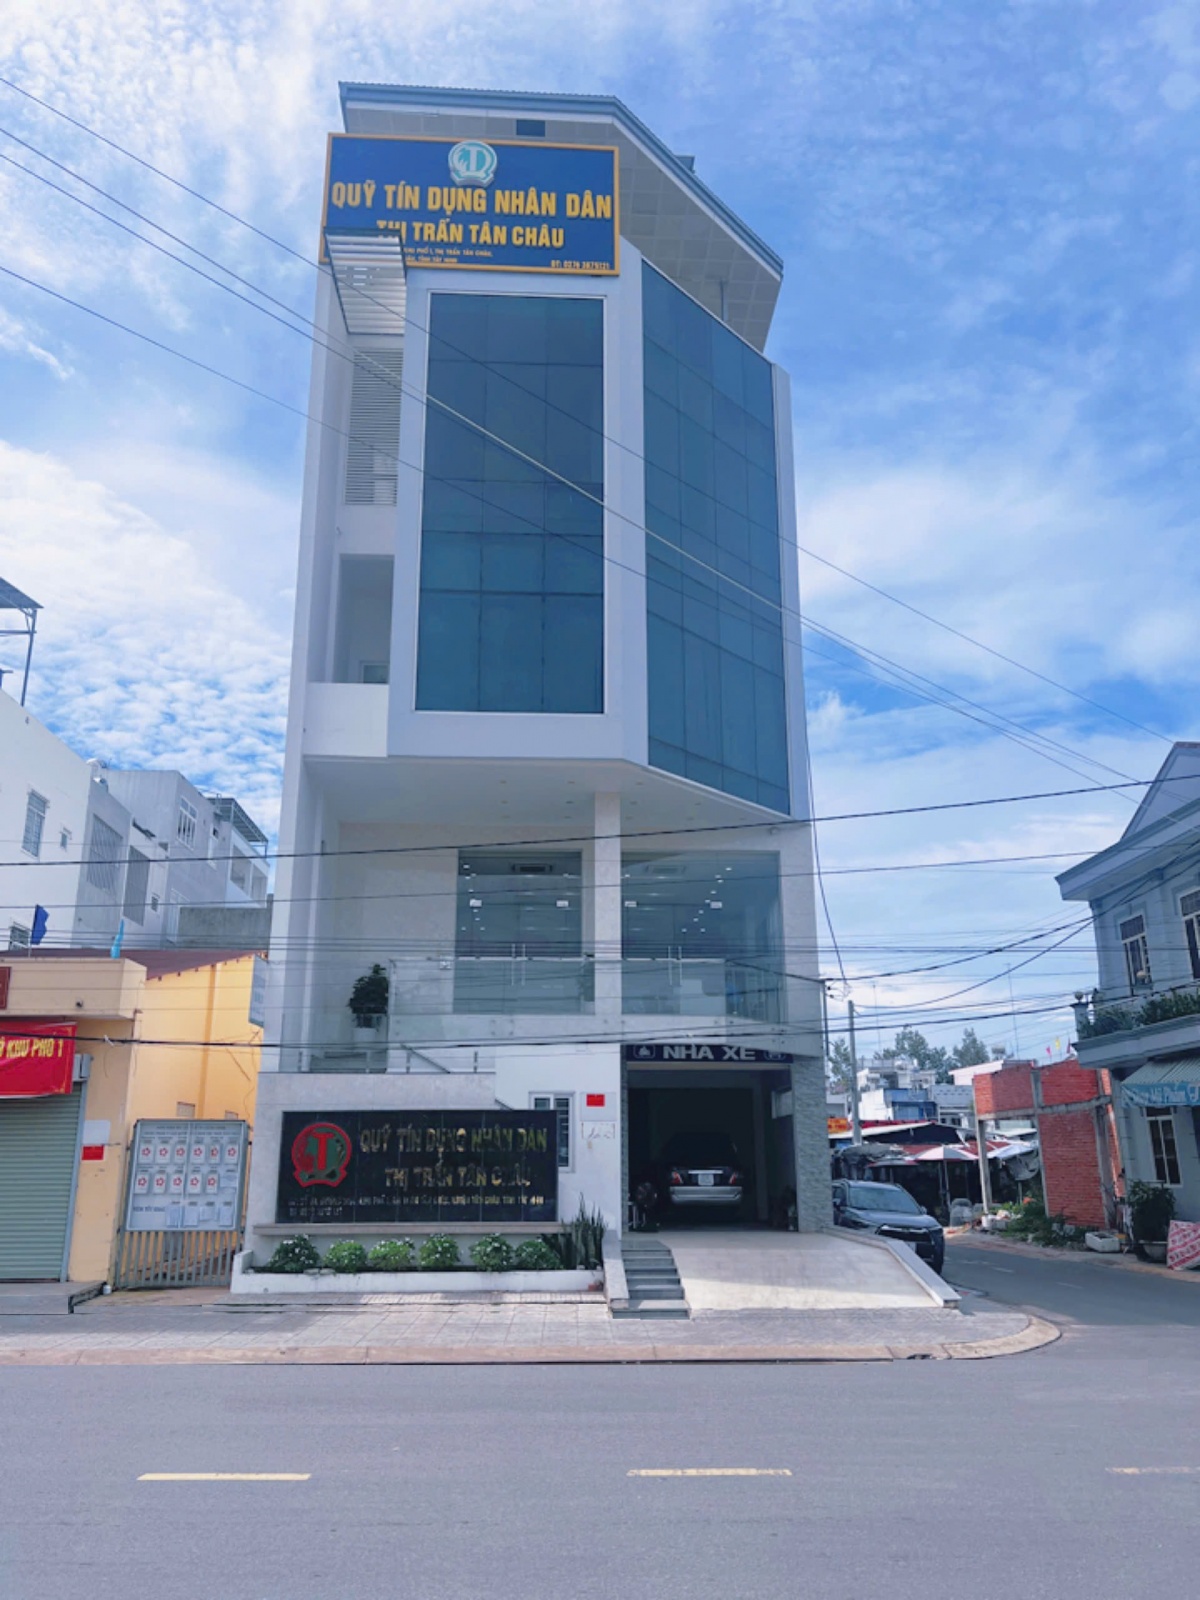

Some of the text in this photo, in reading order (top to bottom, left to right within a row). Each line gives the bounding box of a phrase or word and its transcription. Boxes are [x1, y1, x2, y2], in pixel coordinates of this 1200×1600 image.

[331, 180, 612, 220] QUỸ TÍN DỤNG NHÂN DÂN
[412, 218, 463, 244] TRẤN
[469, 222, 507, 245] TÂN
[512, 226, 565, 249] CHÂU
[6, 1039, 31, 1059] KHU
[721, 1045, 756, 1061] XE
[361, 1123, 392, 1153] QUỸ
[396, 1123, 422, 1153] TÍN
[425, 1128, 467, 1157] DỤNG
[458, 1163, 487, 1187] TÂN
